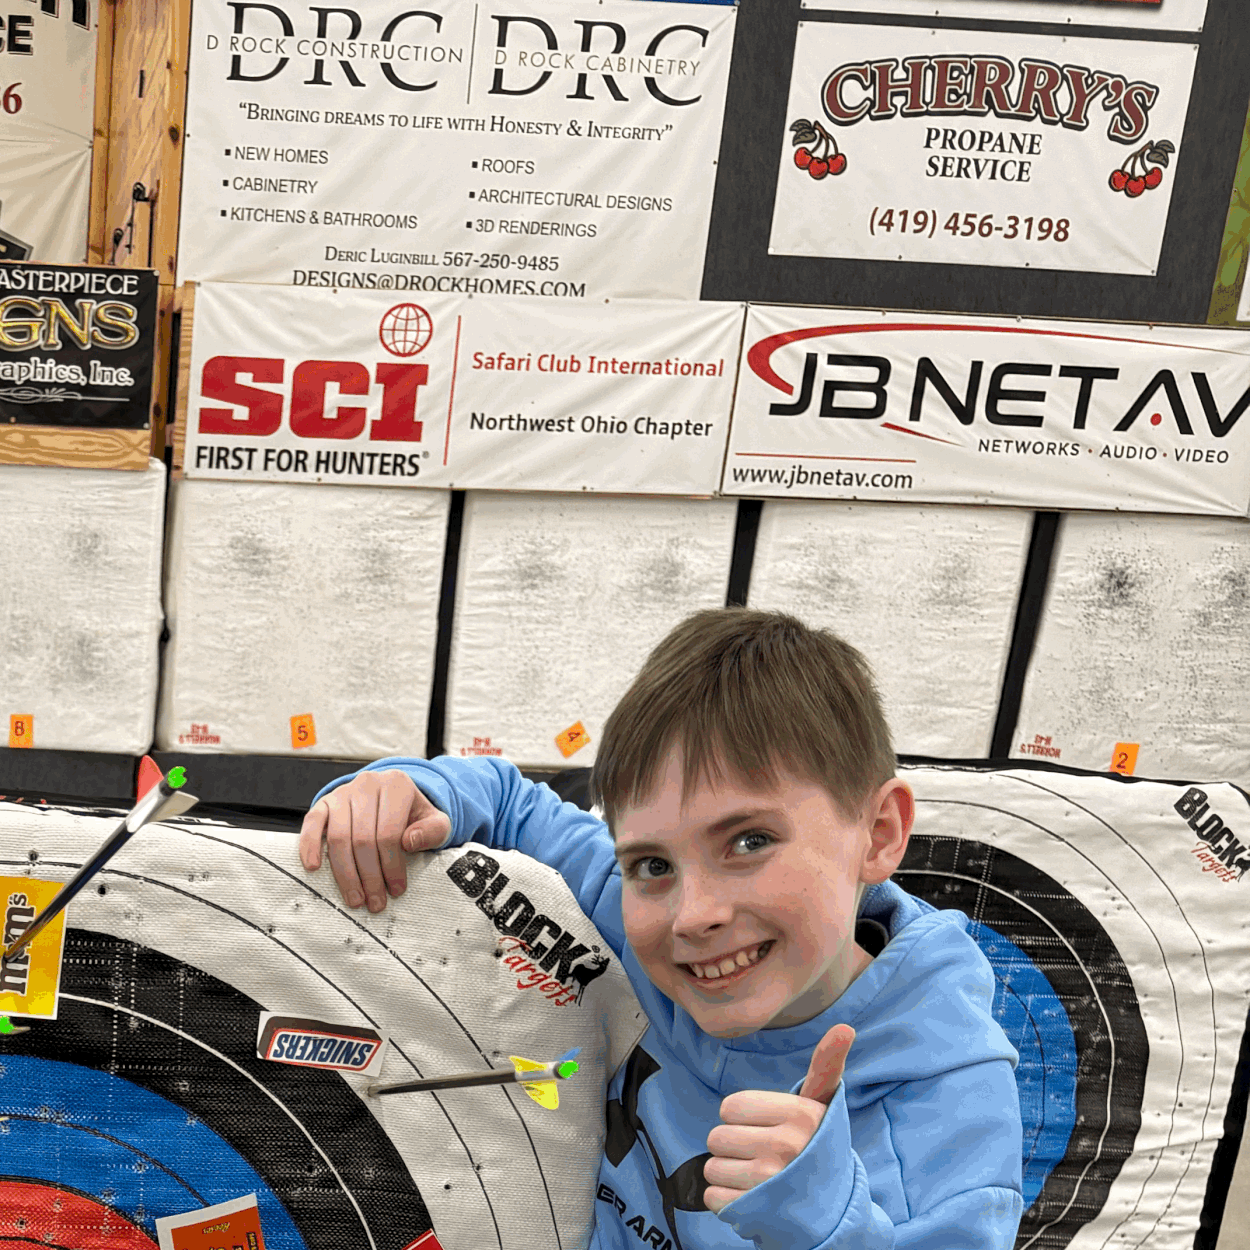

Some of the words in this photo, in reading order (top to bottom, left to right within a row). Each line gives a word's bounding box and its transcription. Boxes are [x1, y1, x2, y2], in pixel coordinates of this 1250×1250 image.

[207, 35, 219, 50] D
[230, 36, 287, 54] ROCK
[297, 39, 463, 63] CONSTRUCTION
[226, 2, 444, 92] DRC
[488, 15, 710, 106] DRC
[495, 50, 507, 66] D
[518, 51, 576, 70] ROCK
[586, 55, 701, 77] CABINETRY
[821, 54, 1159, 145] CHERRY'S
[324, 111, 385, 127] DREAMS
[388, 114, 409, 128] TO
[412, 115, 443, 130] LIFE
[447, 117, 486, 131] WITH
[490, 115, 562, 136] HONESTY
[566, 119, 582, 137] &
[234, 146, 271, 161] NEW
[274, 148, 329, 164] HOMES
[923, 128, 1042, 156] PROPANE
[482, 158, 535, 175] ROOFS
[925, 156, 1032, 183] SERVICE
[233, 176, 318, 194] CABINETRY
[478, 189, 602, 208] ARCHITECTURAL
[606, 195, 673, 212] DESIGNS
[230, 207, 306, 224] KITCHENS
[309, 210, 319, 225] &
[323, 211, 418, 229] BATHROOMS
[475, 219, 494, 233] 3D
[499, 220, 597, 238] RENDERINGS
[869, 206, 937, 239] (419)
[944, 211, 1070, 243] 456-3198
[325, 246, 367, 263] DERIC
[370, 248, 440, 266] LUGINBILL
[442, 252, 559, 271] 567-250-9485
[293, 270, 586, 298] DESIGNS@DROCKHOMES.COM
[89, 360, 135, 387] Inc.
[471, 351, 531, 374] Safari
[536, 353, 582, 375] Club
[587, 356, 724, 378] International
[197, 355, 430, 443] SCI
[469, 411, 575, 434] Northwest
[580, 415, 628, 436] Ohio
[633, 417, 713, 441] Chapter
[195, 445, 257, 472] FIRST
[263, 449, 309, 473] FOR
[978, 439, 1080, 457] NETWORKS
[1099, 444, 1157, 461] AUDIO
[1174, 448, 1229, 464] VIDEO
[732, 463, 914, 490] www.jbnetav.com
[13, 721, 25, 737] 8
[297, 725, 309, 741] 5
[1116, 752, 1129, 769] 2
[1173, 787, 1247, 869] BLOCK
[446, 850, 592, 985] BLOCK
[498, 936, 577, 1006] Targets
[272, 1034, 374, 1066] SNICKERS
